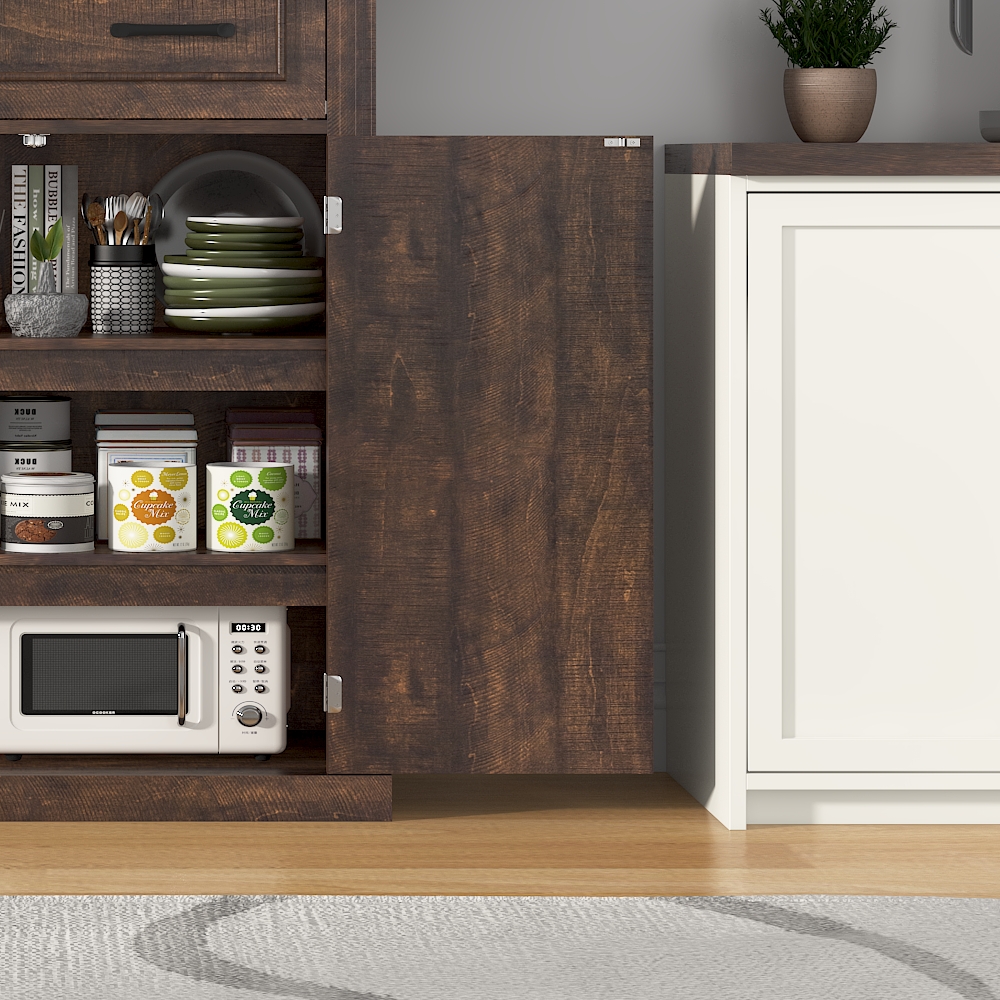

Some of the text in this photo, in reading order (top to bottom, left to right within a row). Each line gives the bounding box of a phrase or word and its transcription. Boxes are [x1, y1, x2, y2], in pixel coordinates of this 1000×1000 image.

[14, 170, 26, 209] THE
[48, 171, 58, 222] BUBBLE
[133, 500, 174, 510] Cupcake
[232, 500, 273, 510] Cupcake
[144, 509, 170, 518] Mix
[243, 509, 269, 518] Mix
